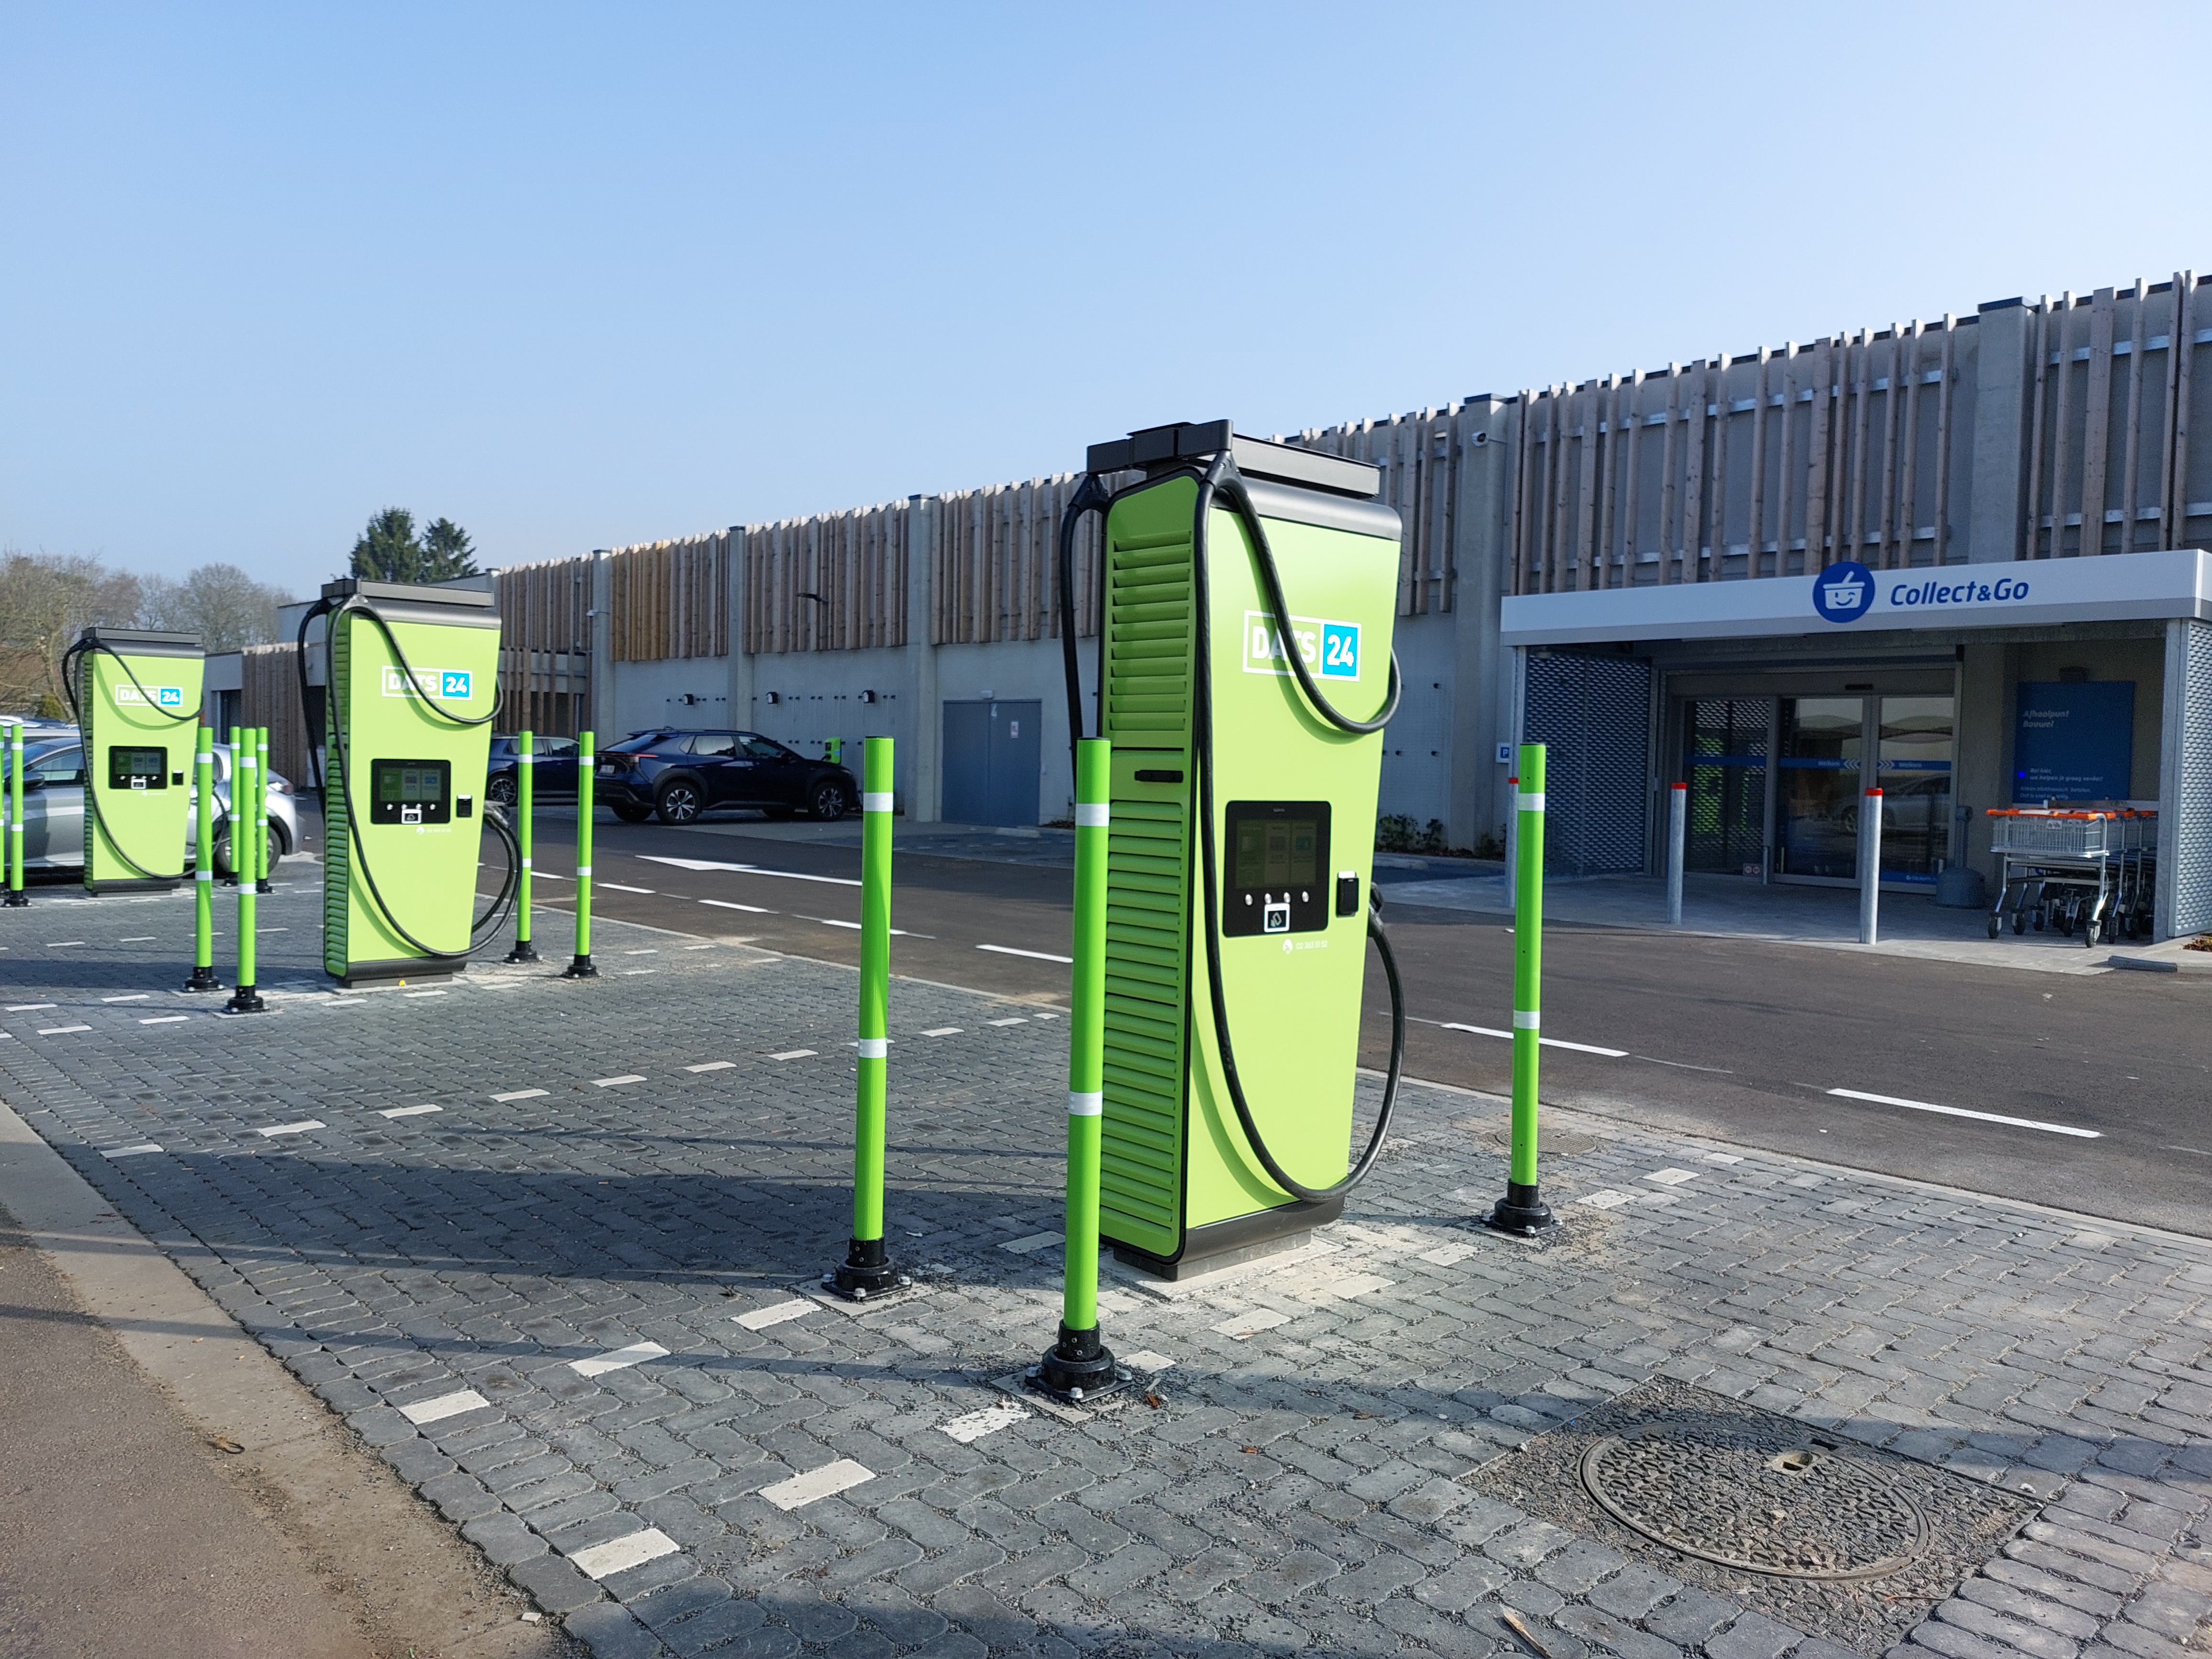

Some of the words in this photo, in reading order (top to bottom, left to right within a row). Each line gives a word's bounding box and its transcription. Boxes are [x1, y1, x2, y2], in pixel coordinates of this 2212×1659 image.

[1890, 578, 2029, 606] Collect&Go
[1327, 634, 1354, 667] 24
[445, 676, 467, 693] 24
[162, 691, 179, 703] 24
